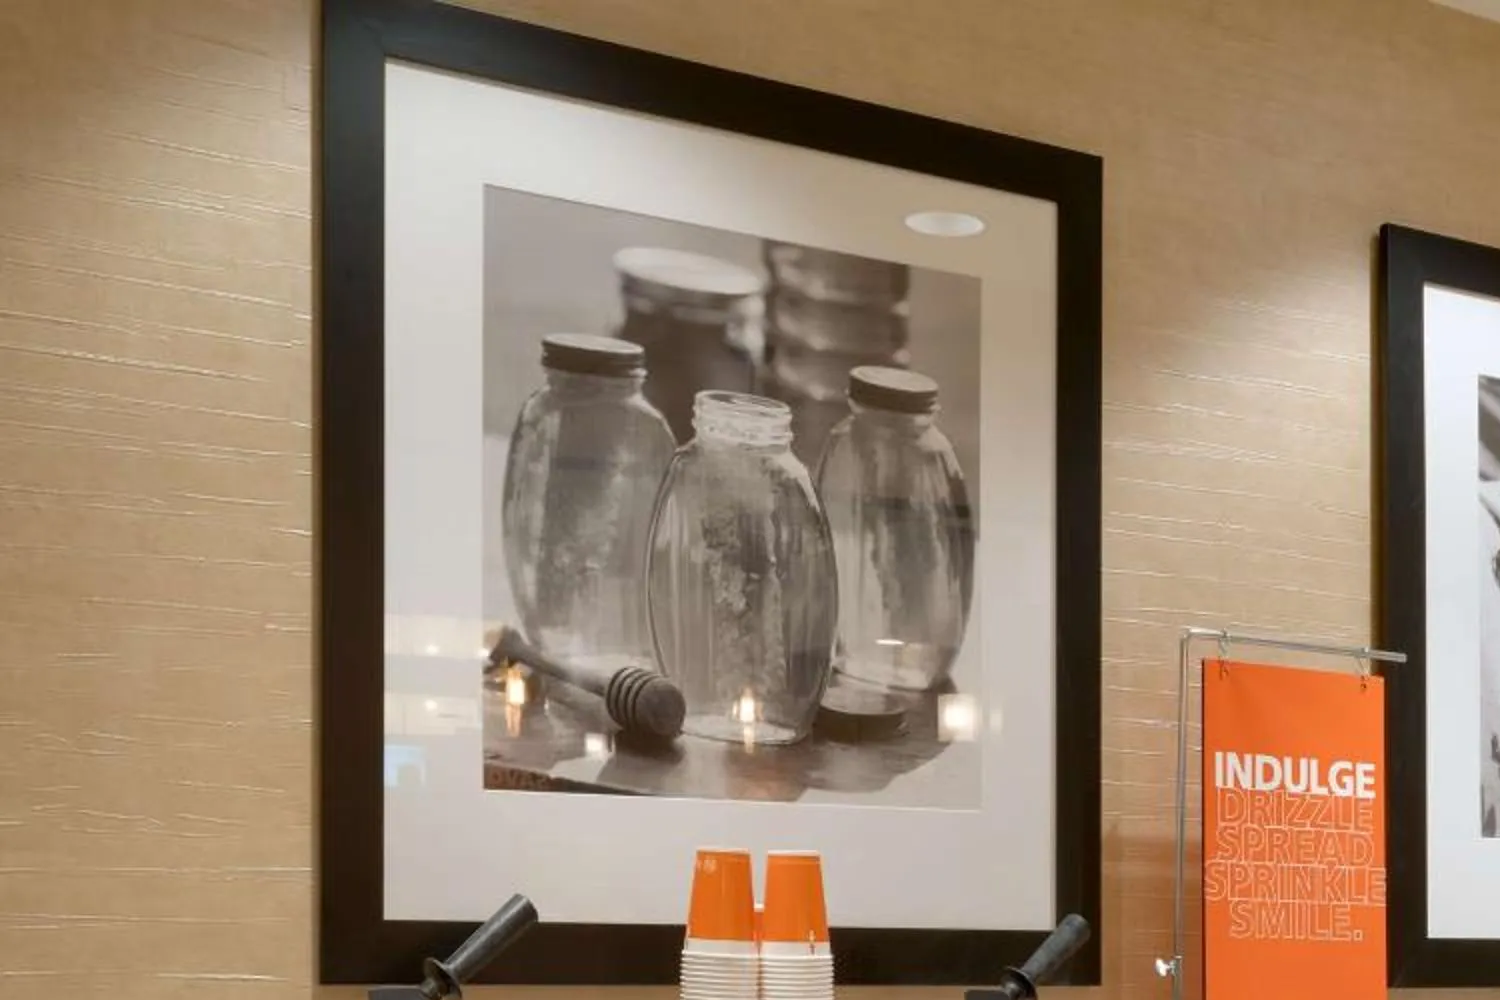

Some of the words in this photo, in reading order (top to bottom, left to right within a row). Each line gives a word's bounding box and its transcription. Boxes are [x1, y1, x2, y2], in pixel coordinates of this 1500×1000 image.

[1214, 751, 1376, 799] INDULGE
[1217, 786, 1374, 834] DRIZZLE
[1215, 823, 1376, 868] SPREAD
[1204, 859, 1387, 907] SPRINKLE
[1229, 900, 1364, 942] SMILE.
